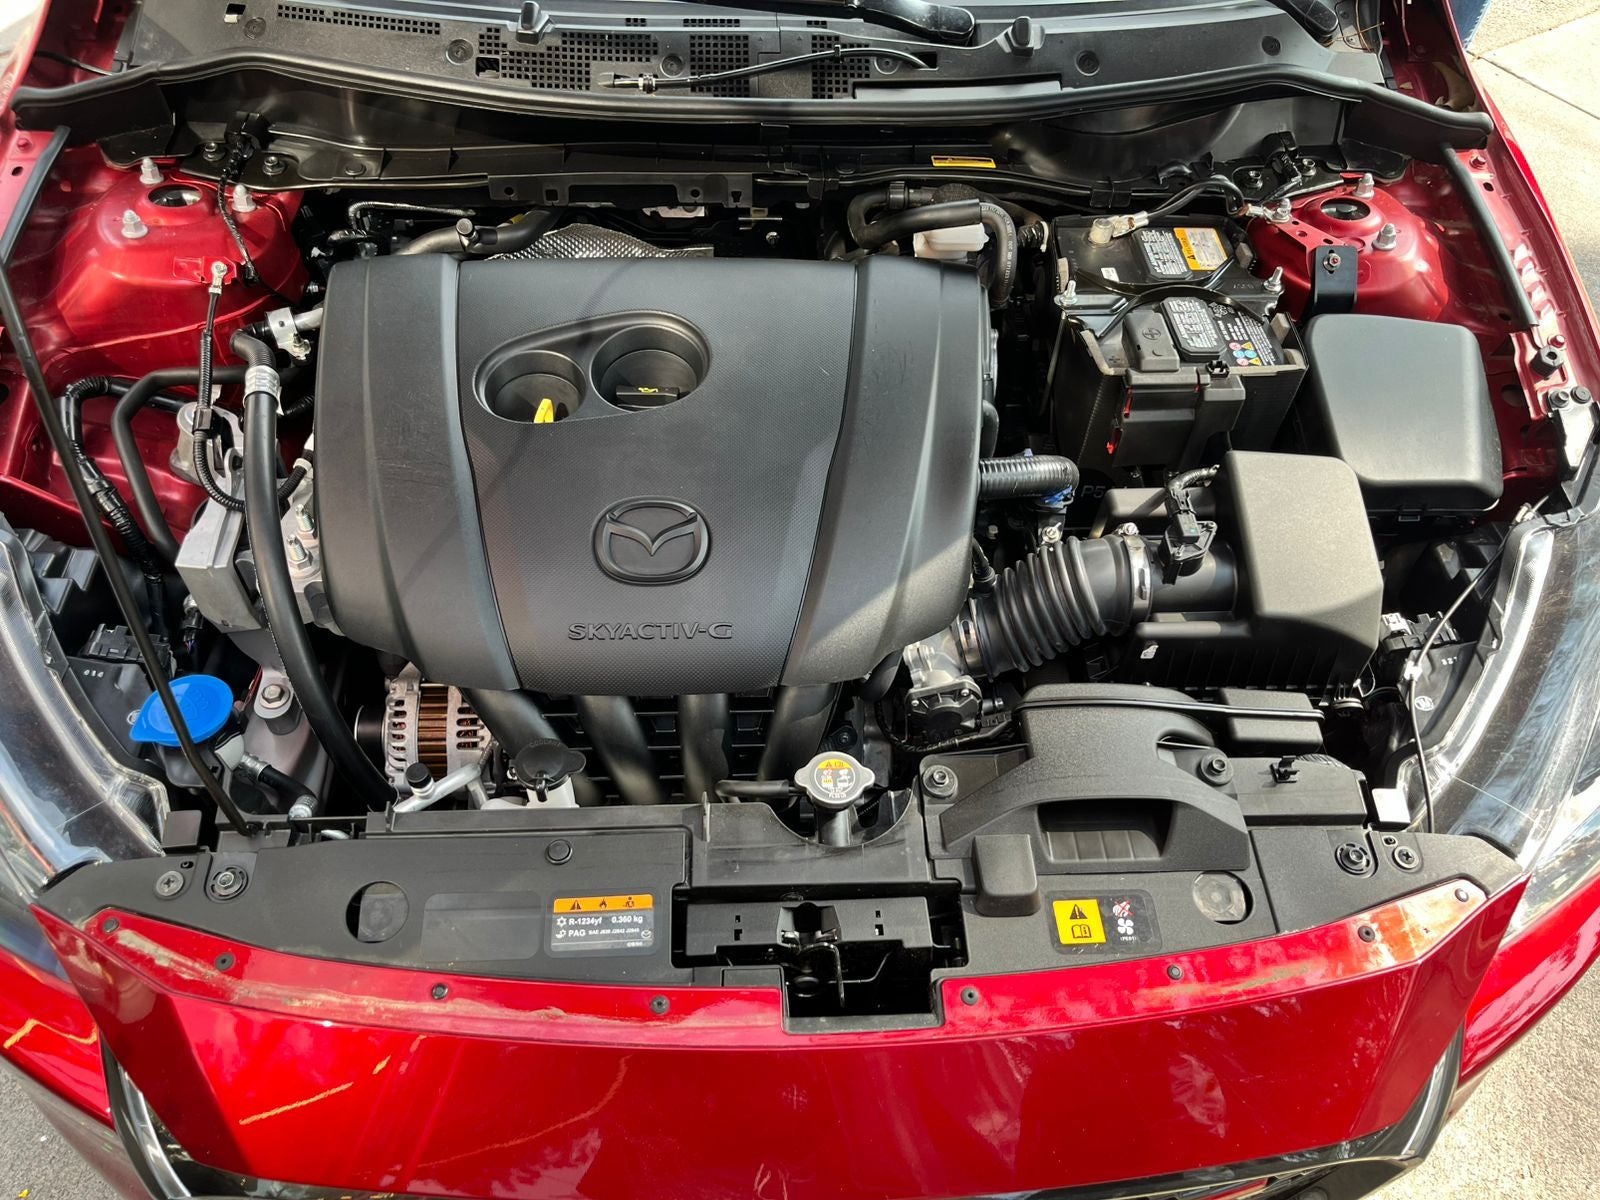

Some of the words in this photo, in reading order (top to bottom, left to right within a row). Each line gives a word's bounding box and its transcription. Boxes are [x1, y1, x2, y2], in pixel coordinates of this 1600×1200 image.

[568, 621, 733, 640] SKYACTIV-G
[568, 917, 602, 926] R-1234yf
[633, 915, 643, 924] kg
[568, 929, 586, 937] PAG
